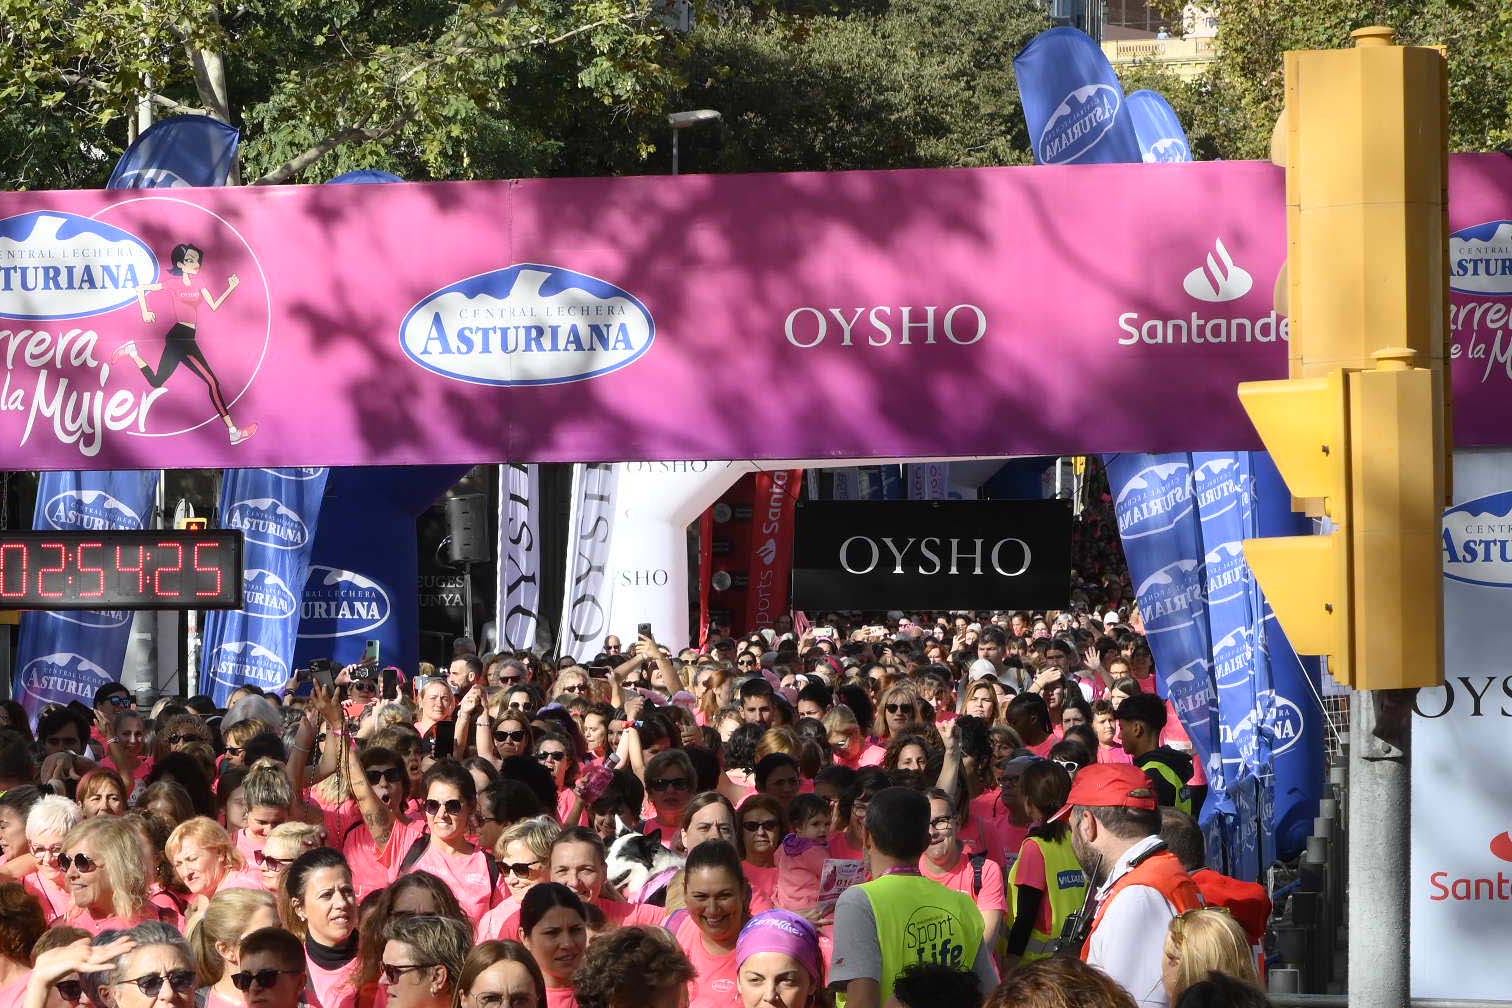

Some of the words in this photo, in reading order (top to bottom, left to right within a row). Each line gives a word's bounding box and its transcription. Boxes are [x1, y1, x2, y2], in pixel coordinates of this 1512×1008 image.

[62, 249, 134, 260] LECHERA
[459, 306, 537, 319] CENTRAL
[546, 305, 626, 317] LECHERA
[784, 303, 987, 348] OYSHO
[1119, 311, 1288, 345] Santande
[420, 311, 634, 356] ASTURIANA
[0, 370, 25, 412] la
[20, 364, 168, 457] Mujer
[763, 472, 787, 534] Santa
[232, 510, 301, 543] ASTURIANA
[0, 543, 222, 597] 02:54:25
[505, 463, 537, 650] OYSH
[571, 463, 612, 642] OYSH
[839, 535, 1032, 577] OYSHO
[619, 569, 668, 587] SHO
[755, 570, 773, 627] ports
[302, 601, 381, 620] URIANA
[29, 668, 98, 698] ASTURIA
[1413, 676, 1512, 719] OYS
[908, 914, 954, 949] Sport
